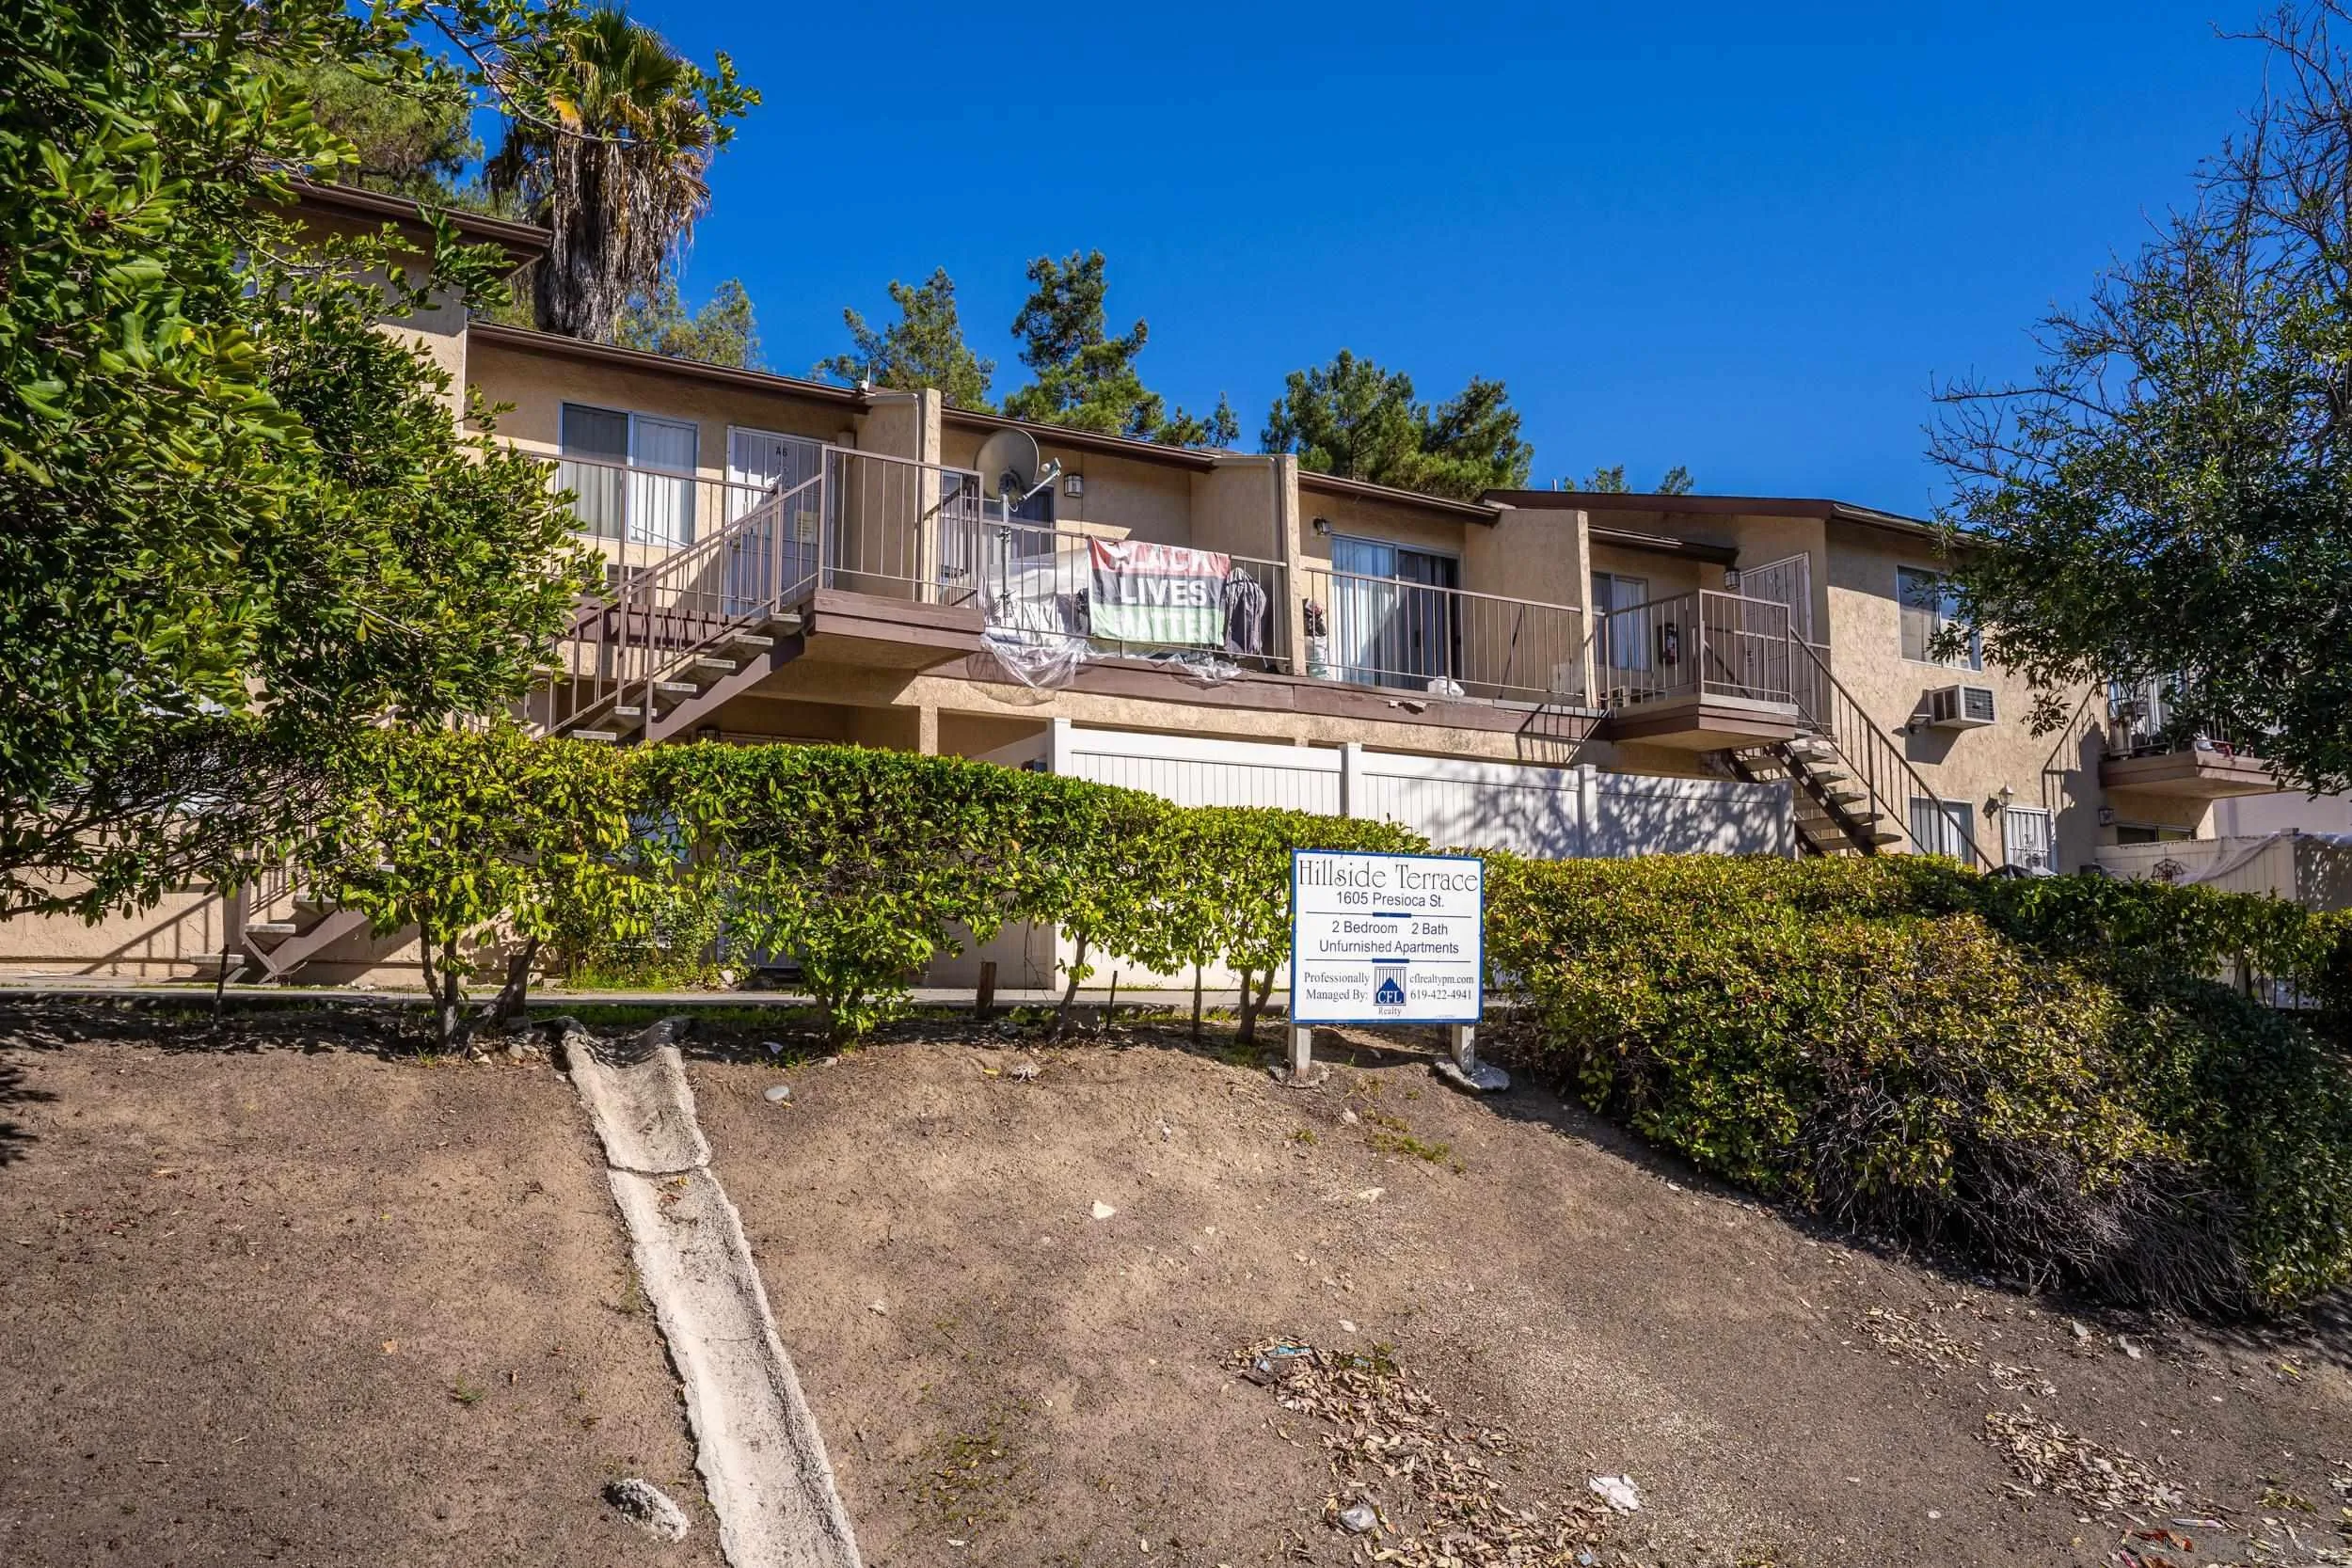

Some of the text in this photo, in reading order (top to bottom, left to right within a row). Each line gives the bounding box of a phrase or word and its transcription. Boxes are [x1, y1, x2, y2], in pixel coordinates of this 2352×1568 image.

[1119, 577, 1207, 607] LIVES
[1298, 858, 1479, 892] Hillside Terrace
[1337, 891, 1444, 908] 1605 Presioca St.
[1331, 920, 1449, 935] 2 Bedroom 2 Bath
[1319, 940, 1459, 956] Unfurnished Apartments
[1304, 972, 1370, 986] Professionally
[1306, 989, 1368, 1003] Managed By:
[1377, 990, 1402, 1004] CFL
[1410, 990, 1471, 1001] 619-422-4941
[1377, 1006, 1402, 1017] Realty
